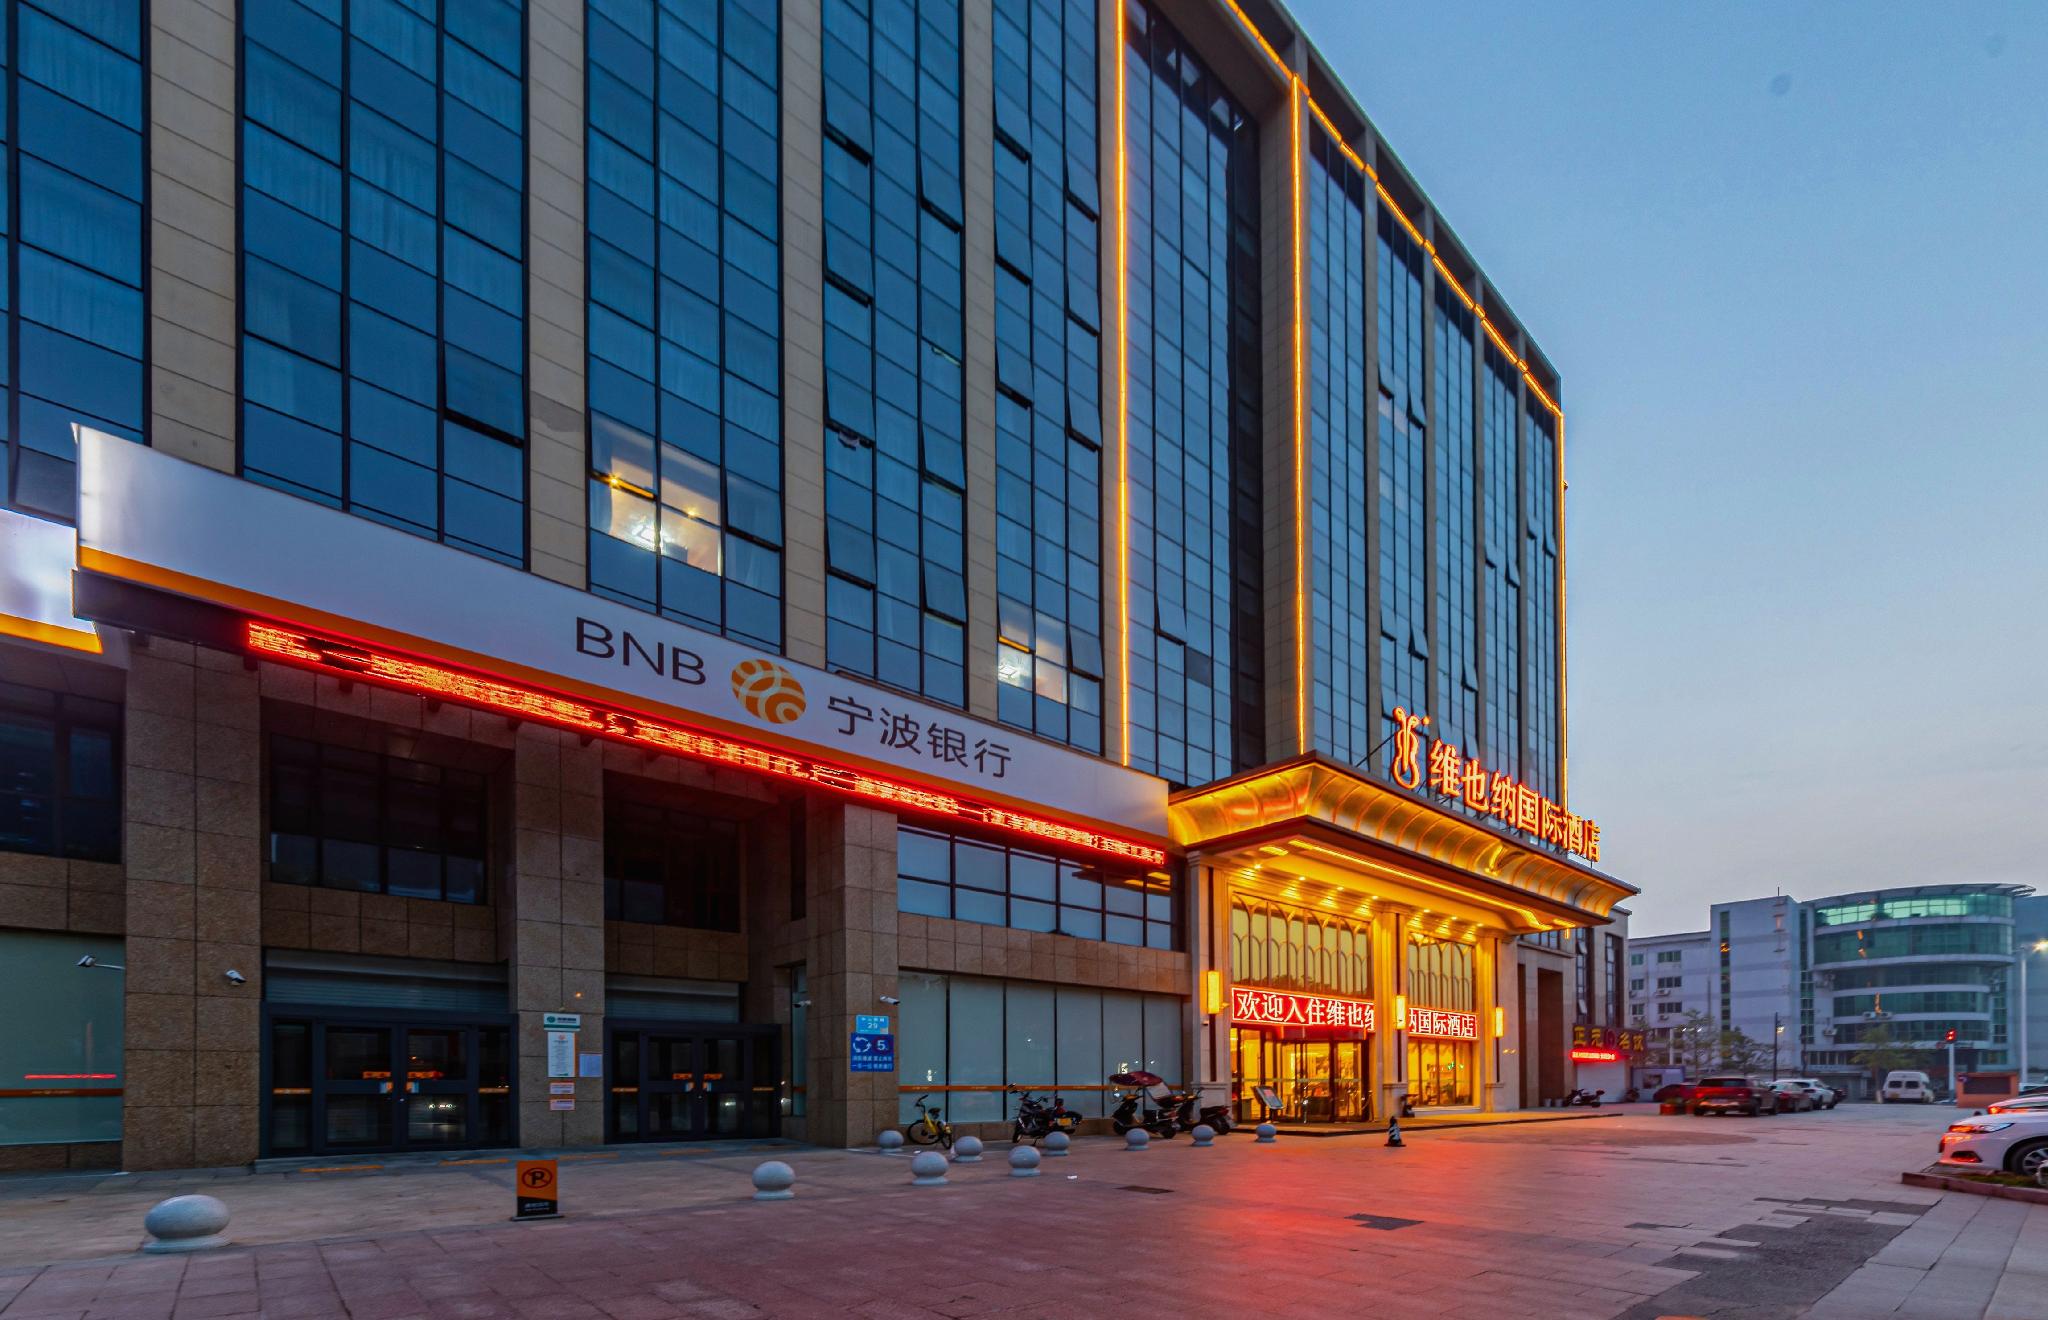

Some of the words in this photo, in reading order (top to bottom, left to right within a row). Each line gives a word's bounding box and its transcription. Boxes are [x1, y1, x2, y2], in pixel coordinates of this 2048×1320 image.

[576, 616, 706, 686] BNB
[827, 695, 1013, 778] 宁波银行
[1428, 739, 1601, 862] 维也纳国际酒店
[877, 1039, 886, 1051] 5
